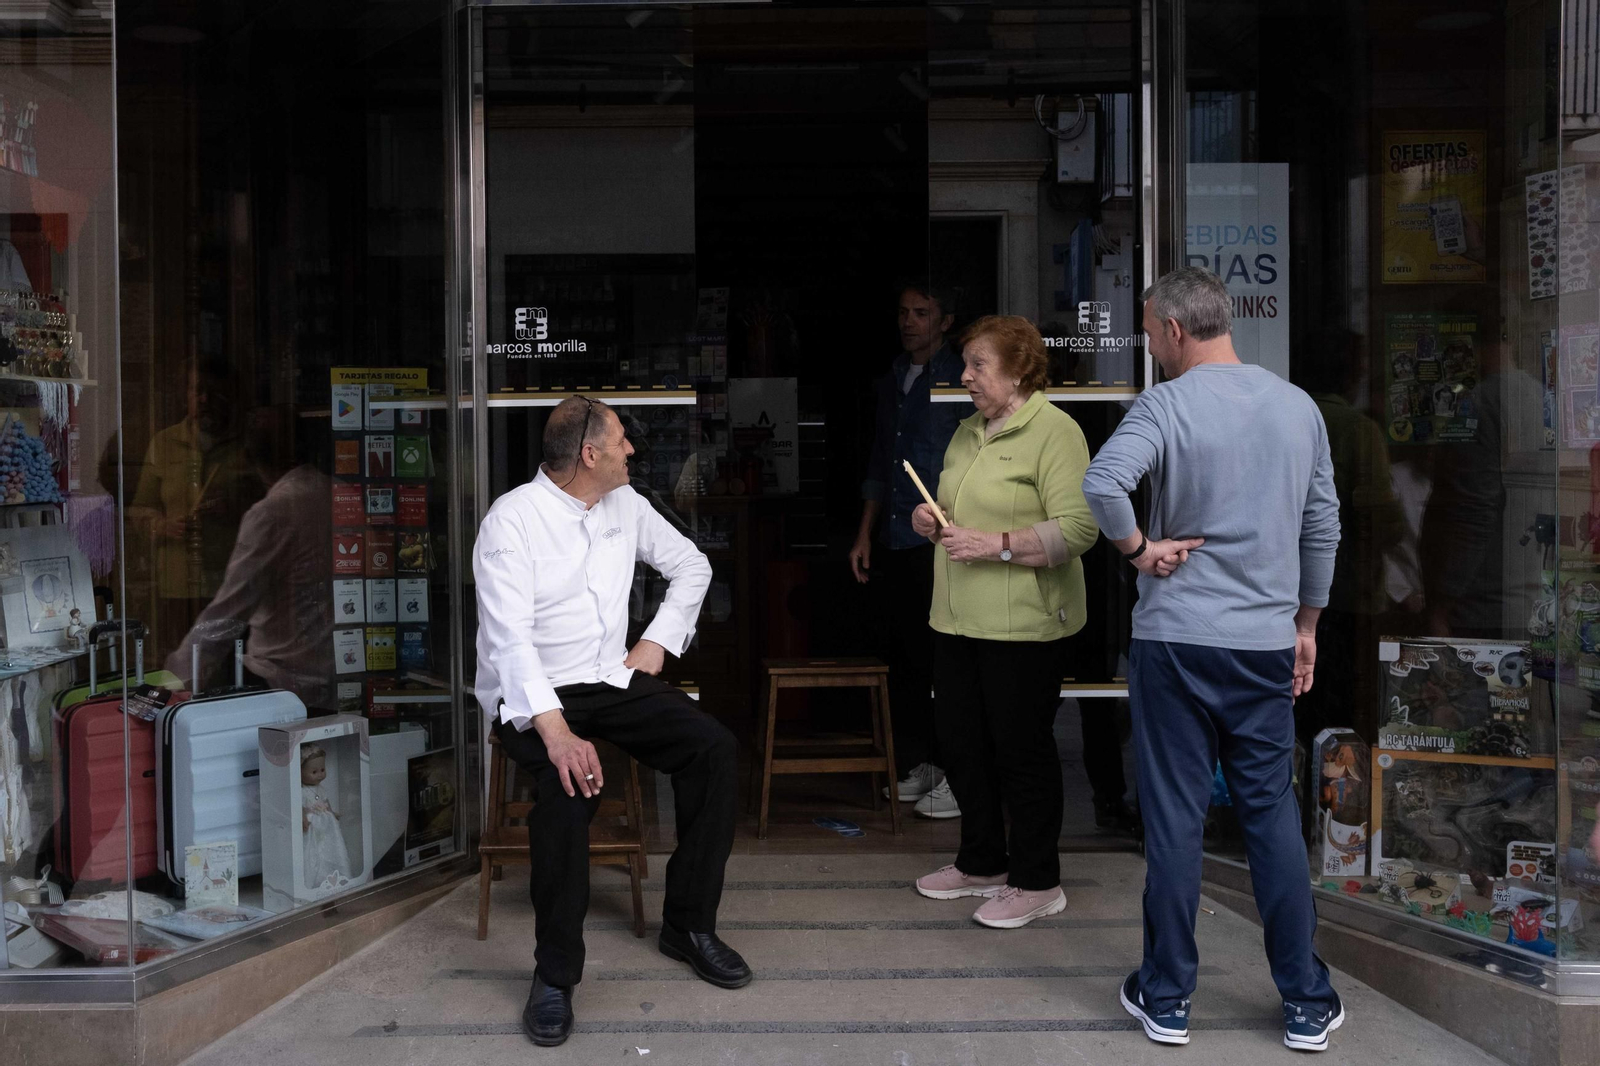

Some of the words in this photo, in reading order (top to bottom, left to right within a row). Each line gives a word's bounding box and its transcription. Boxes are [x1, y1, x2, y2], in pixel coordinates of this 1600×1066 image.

[1389, 141, 1468, 160] OFERTAS
[537, 339, 587, 353] morilla
[1042, 336, 1095, 347] marcos
[1100, 334, 1145, 347] morill
[1386, 733, 1398, 745] RC
[1399, 732, 1456, 749] TARÁNTULA
[1515, 747, 1527, 755] 6+
[1493, 895, 1511, 903] ALIVE
